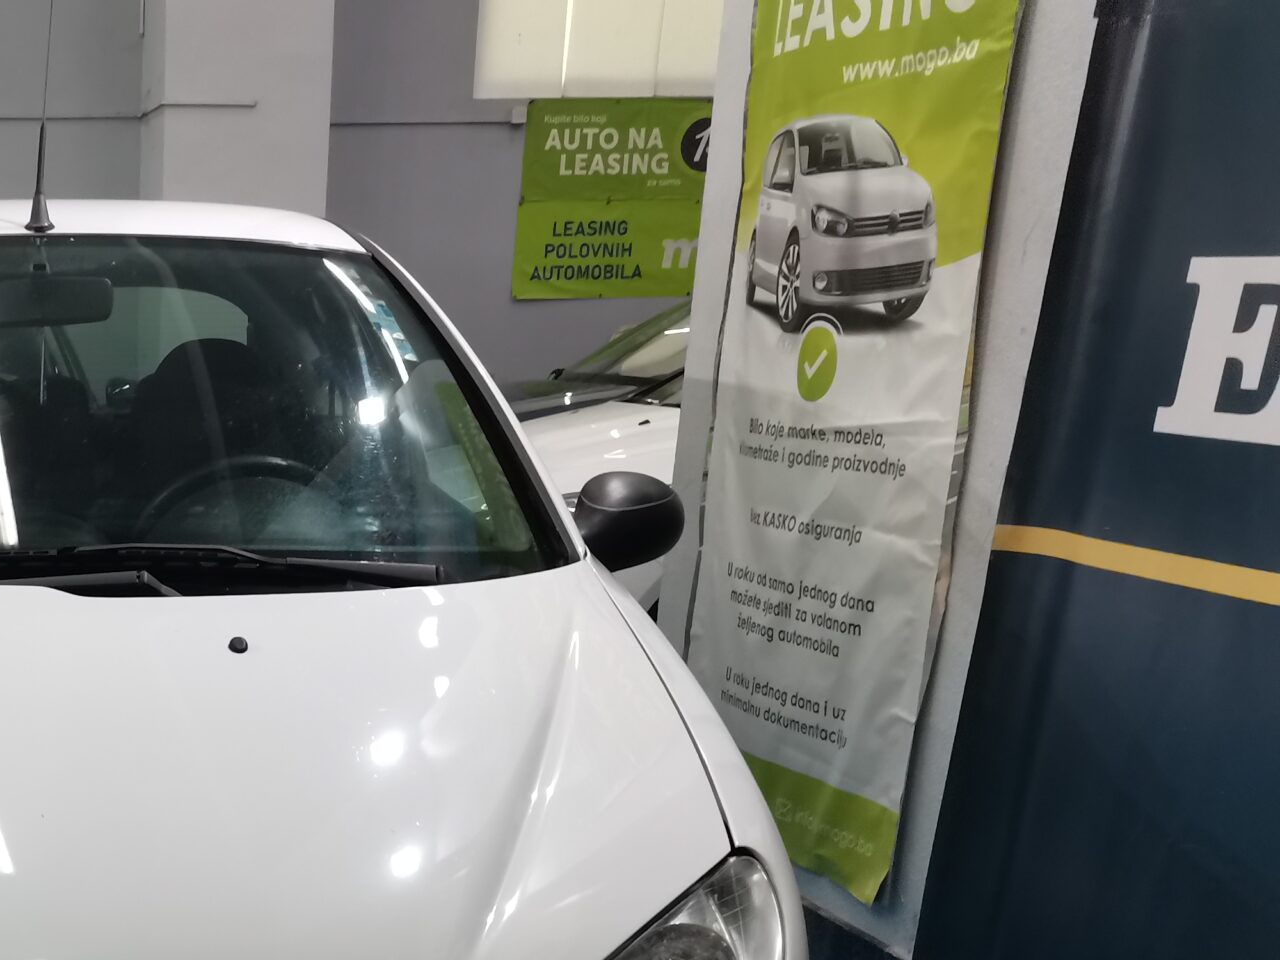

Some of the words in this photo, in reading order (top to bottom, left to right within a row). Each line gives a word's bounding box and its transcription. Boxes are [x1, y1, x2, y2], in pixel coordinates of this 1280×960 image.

[773, 0, 976, 57] LEAS
[843, 35, 980, 84] www.mogo.ba
[544, 114, 571, 125] Kupite
[544, 127, 619, 151] AUTO
[628, 127, 663, 149] NA
[559, 152, 670, 176] LEASING
[552, 220, 628, 237] LEASING
[544, 243, 633, 259] POLOVNIH
[530, 264, 642, 281] AUTOMOBILA
[749, 417, 763, 435] Bilo
[765, 420, 785, 441] koje
[833, 429, 886, 449] modela,
[738, 441, 779, 463] etraže
[787, 450, 829, 469] godine
[831, 453, 906, 480] proizvodnje
[762, 511, 796, 532] KASKO
[797, 518, 863, 547] osiguranja
[727, 561, 733, 577] U
[734, 565, 755, 584] roku
[756, 572, 767, 587] od
[768, 577, 795, 595] samo
[798, 580, 837, 609] jednog
[840, 591, 875, 613] dana
[737, 612, 774, 643] željenog
[778, 628, 840, 658] automobila
[795, 608, 807, 622] za
[810, 612, 862, 637] volanom
[725, 665, 732, 681] U
[733, 672, 750, 690] roku
[750, 677, 787, 707] jednog
[790, 692, 820, 714] dana
[832, 707, 847, 721] uz
[720, 689, 761, 719] minimalnu
[763, 706, 848, 750] dokumentaciju
